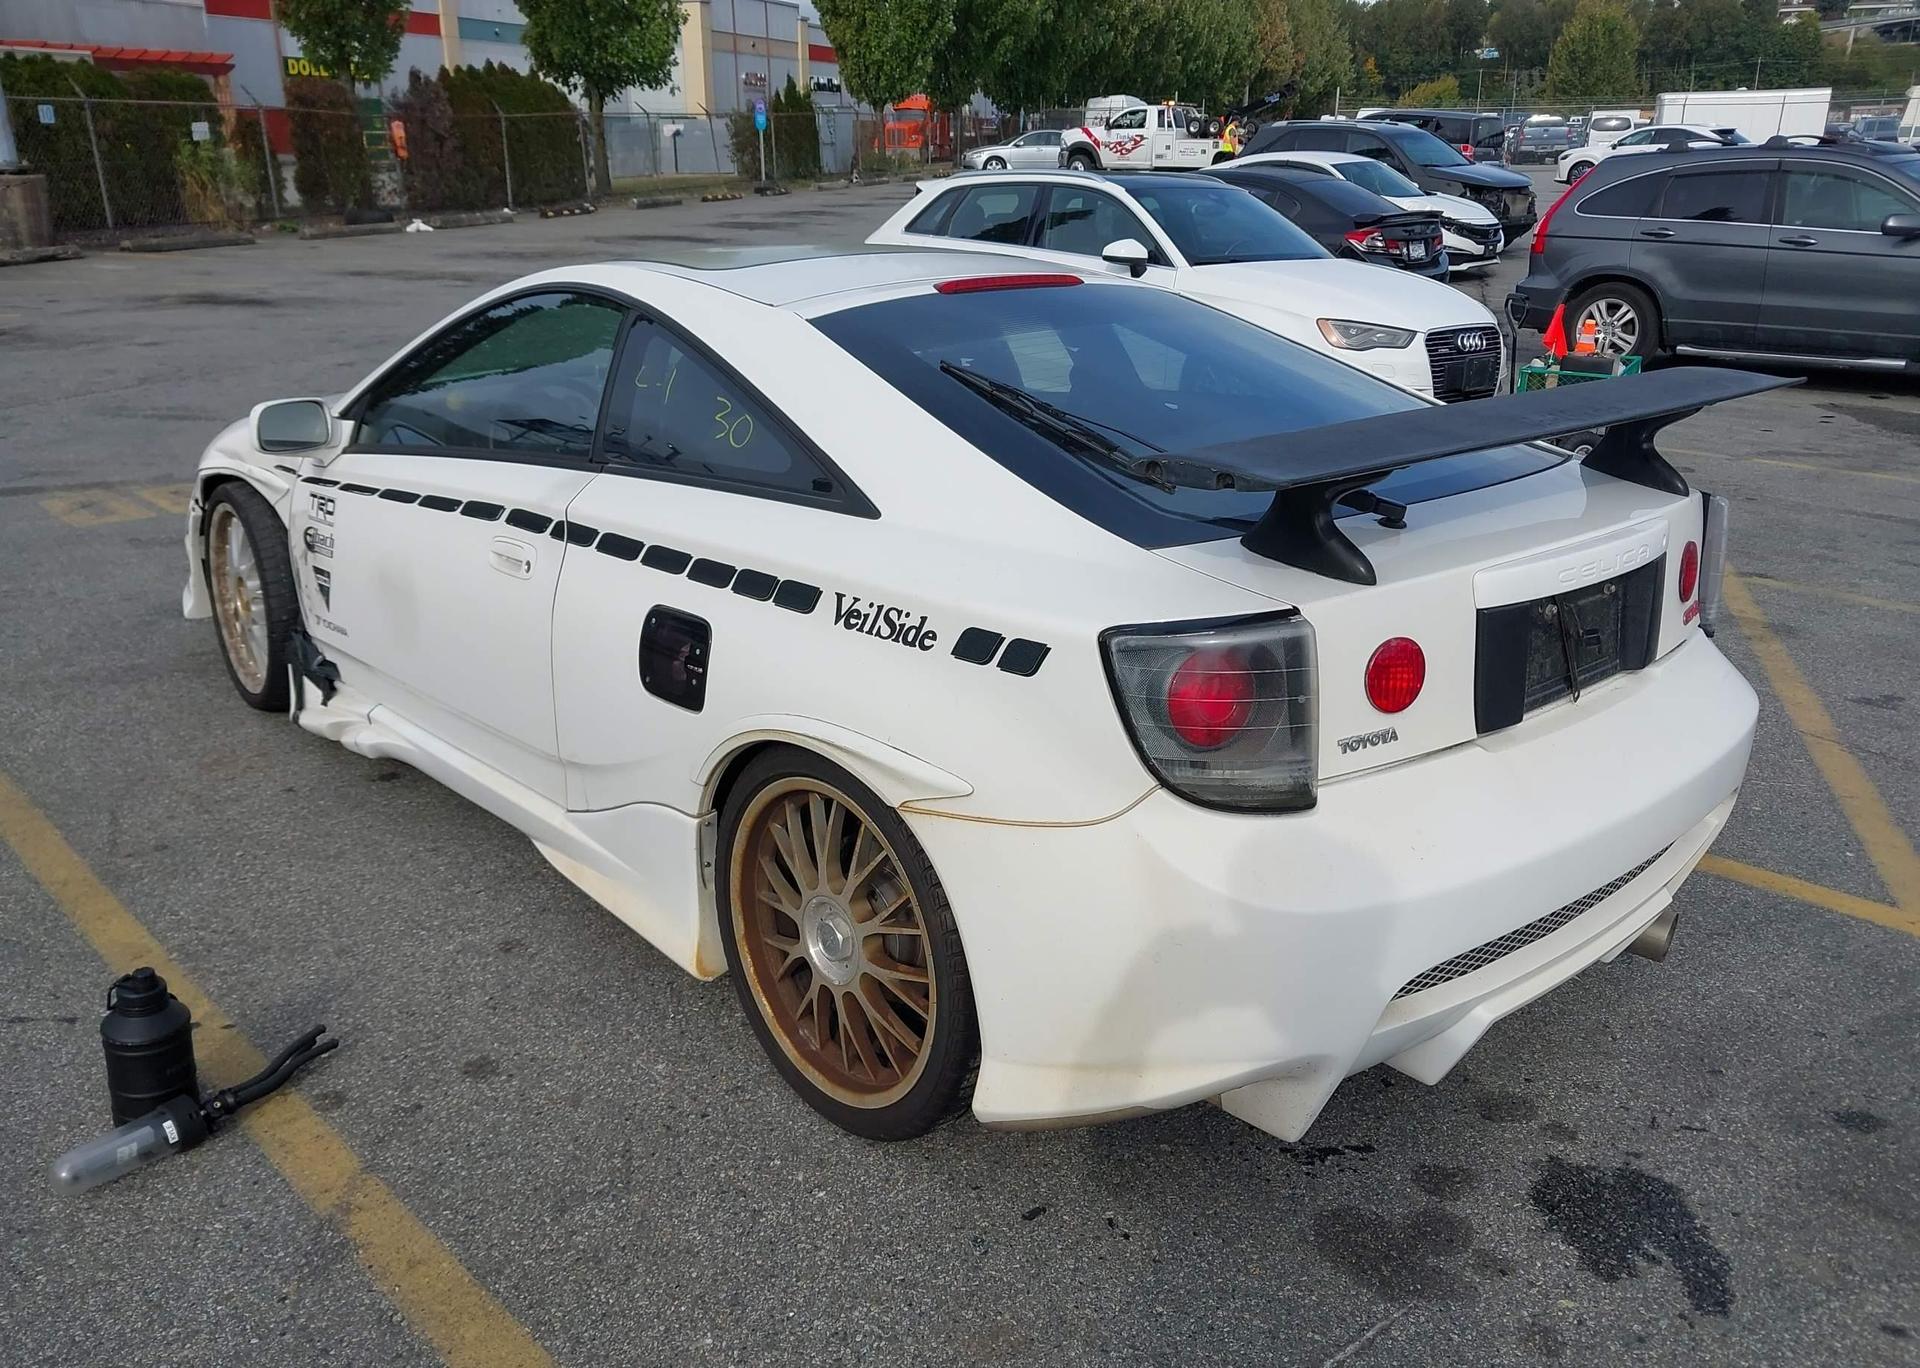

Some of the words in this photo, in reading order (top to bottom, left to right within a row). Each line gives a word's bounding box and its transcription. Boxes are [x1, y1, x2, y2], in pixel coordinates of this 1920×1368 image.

[714, 396, 754, 448] 30
[1559, 543, 1651, 586] CELICA
[834, 591, 938, 652] VeilSide
[1336, 726, 1399, 755] TOYOTA
